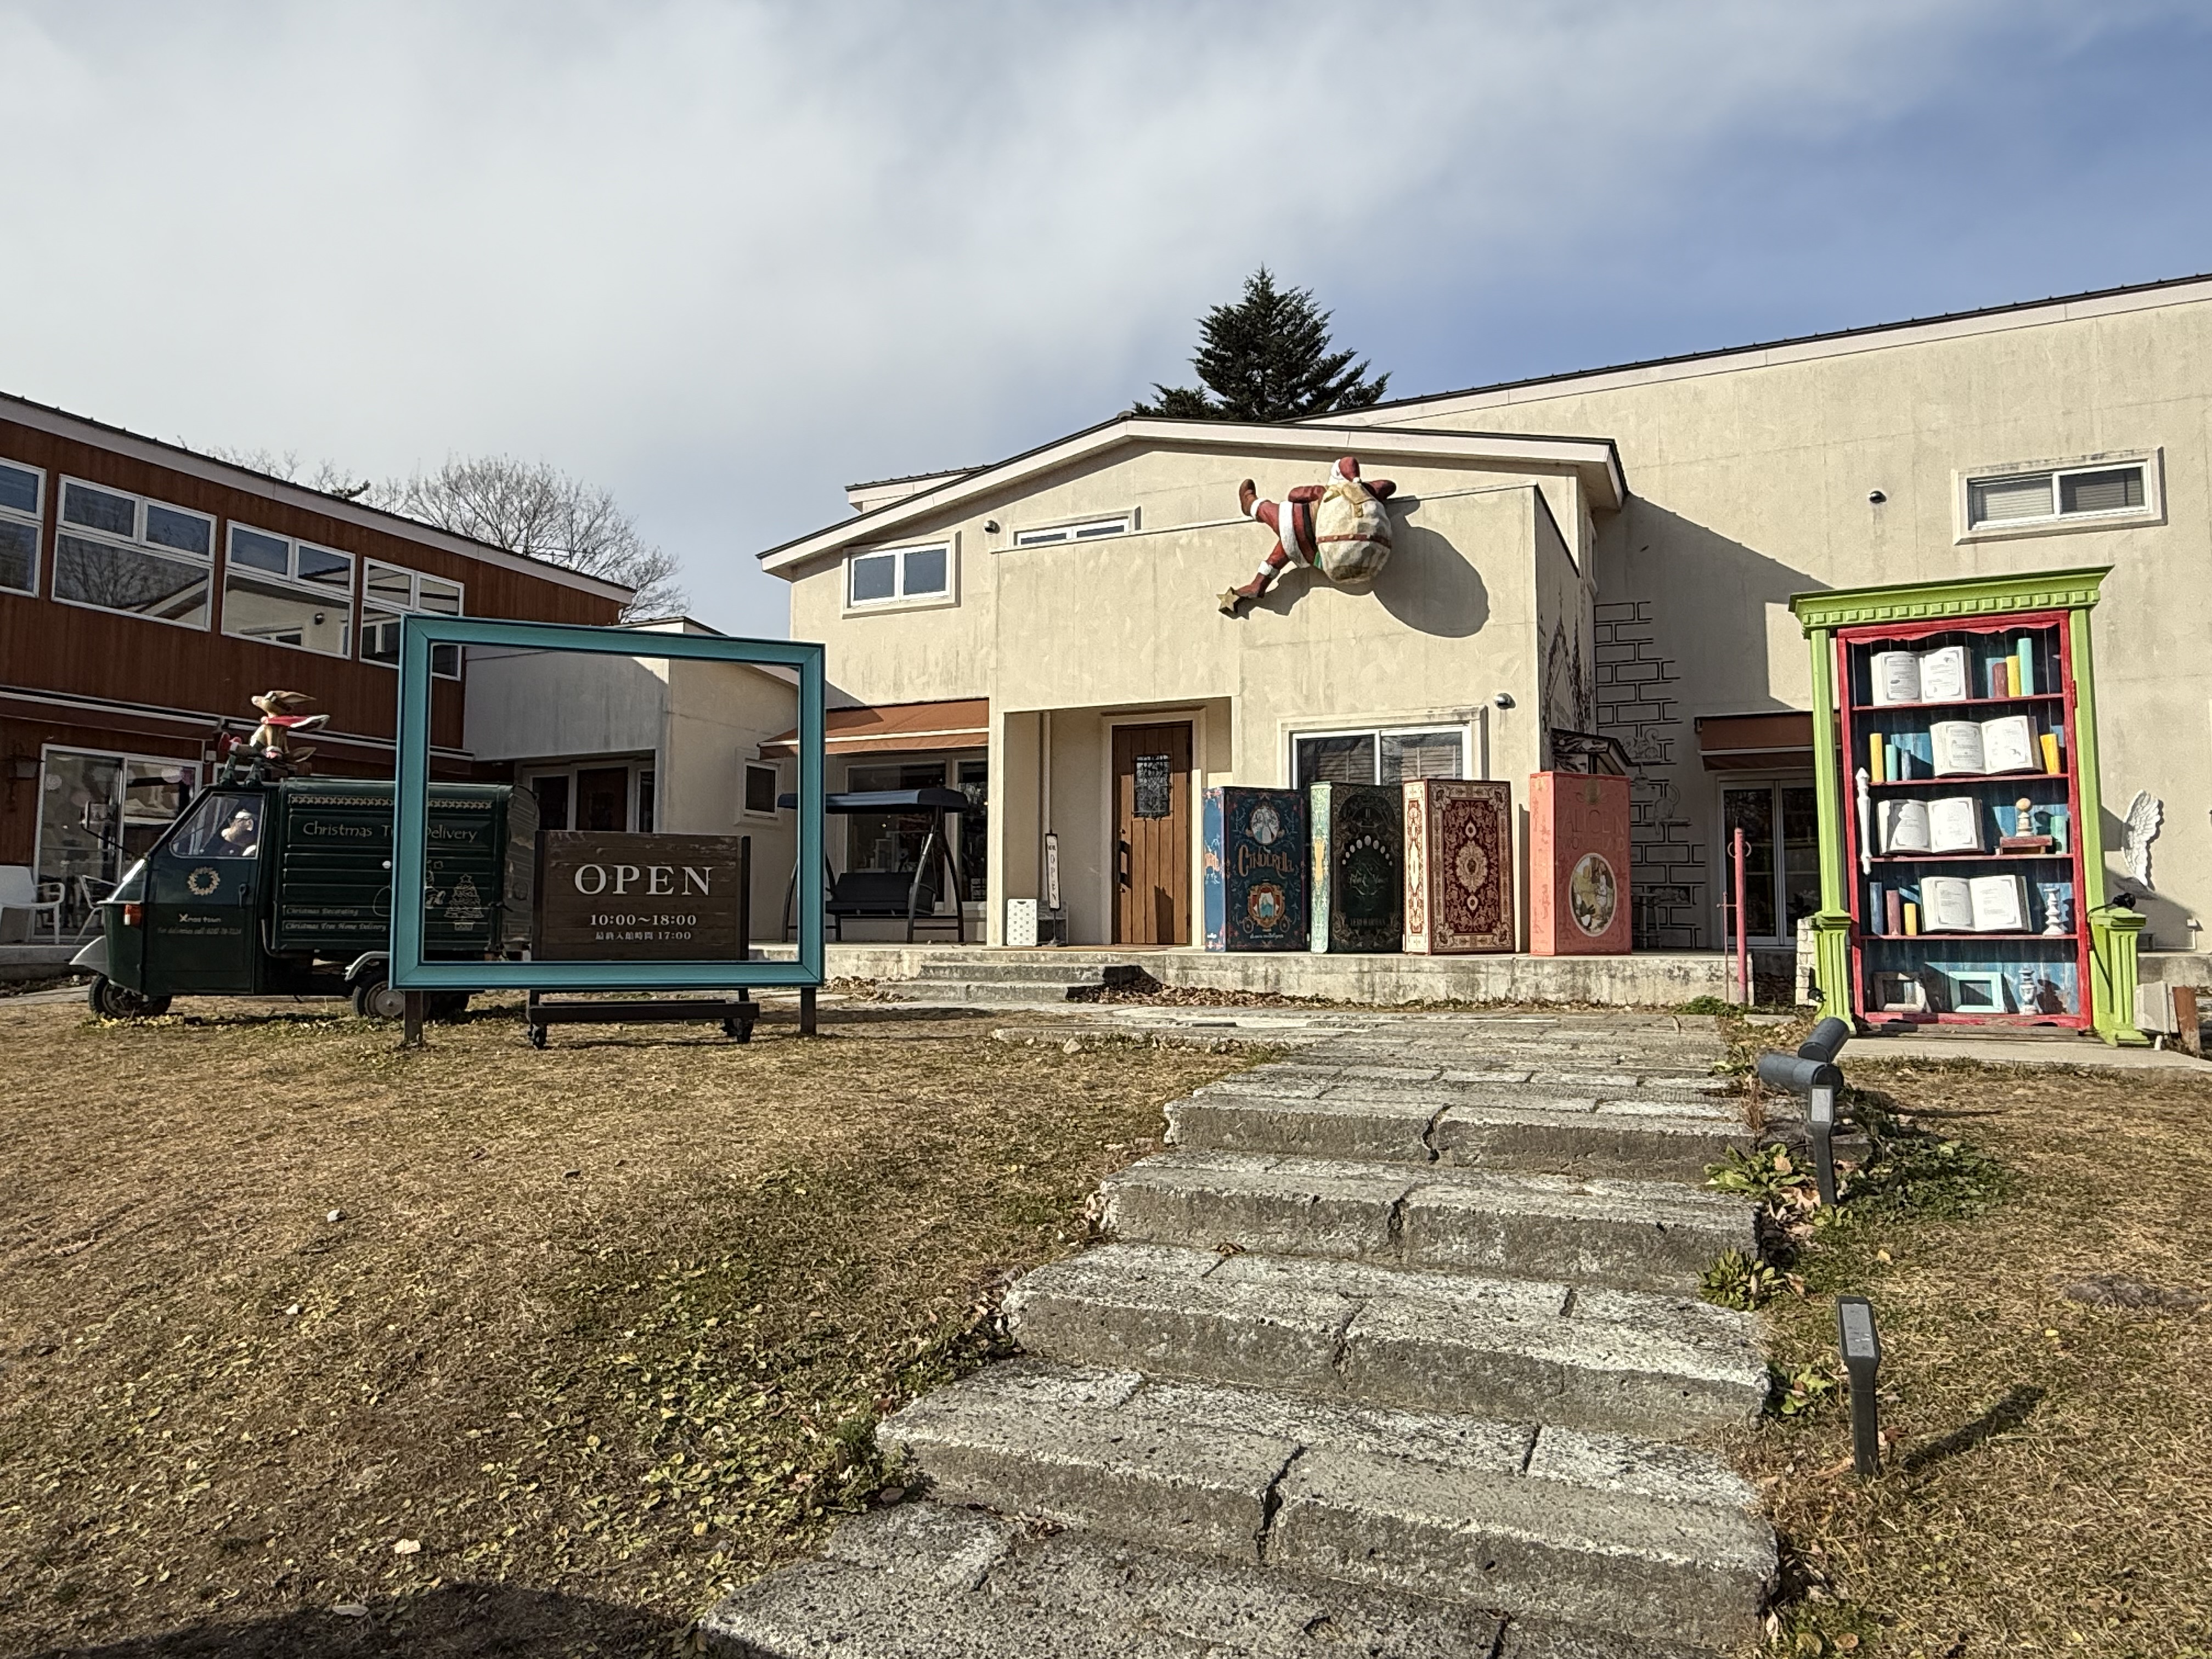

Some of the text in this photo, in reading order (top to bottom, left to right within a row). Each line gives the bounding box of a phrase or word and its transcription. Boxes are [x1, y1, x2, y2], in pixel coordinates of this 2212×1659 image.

[303, 821, 373, 837] Christmas
[574, 864, 713, 895] OPEN
[658, 932, 692, 940] 17:00
